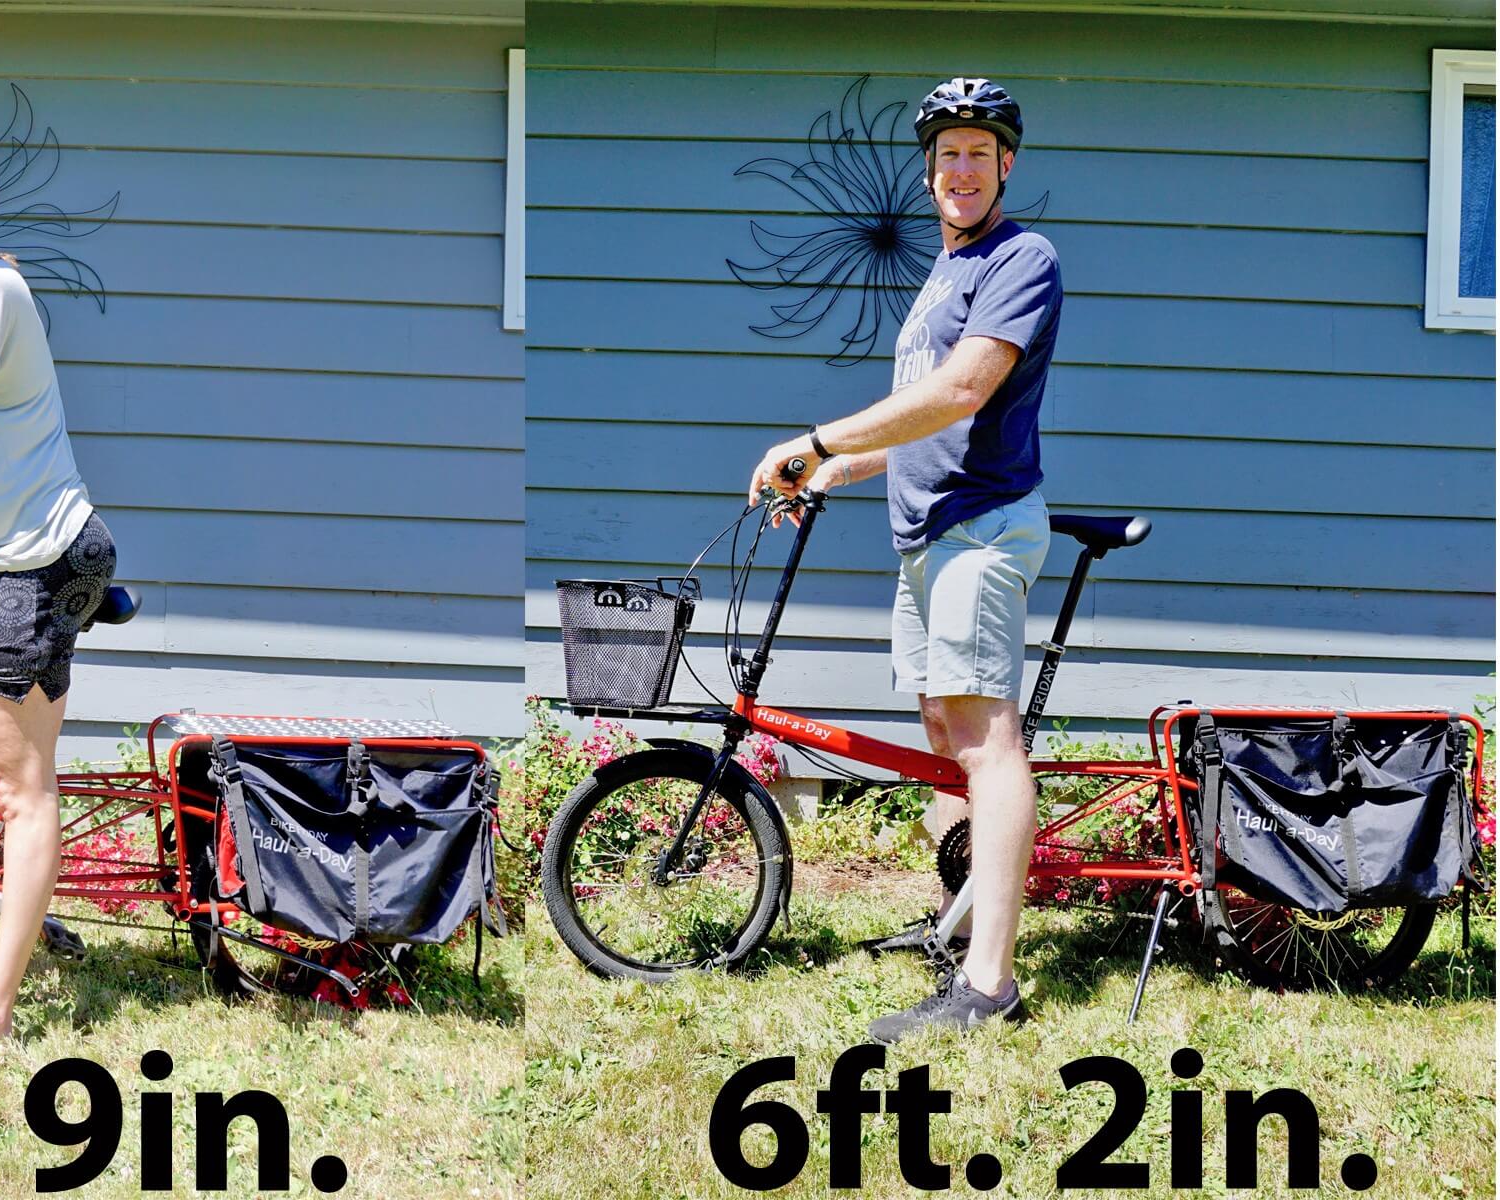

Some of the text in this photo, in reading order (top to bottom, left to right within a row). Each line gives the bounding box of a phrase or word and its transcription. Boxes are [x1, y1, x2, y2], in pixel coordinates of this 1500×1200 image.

[757, 709, 831, 740] Haul-a-Day
[270, 817, 328, 842] BIKE FDAY
[1236, 808, 1339, 852] Haul-a-Day
[252, 828, 353, 873] Haul-a-Day
